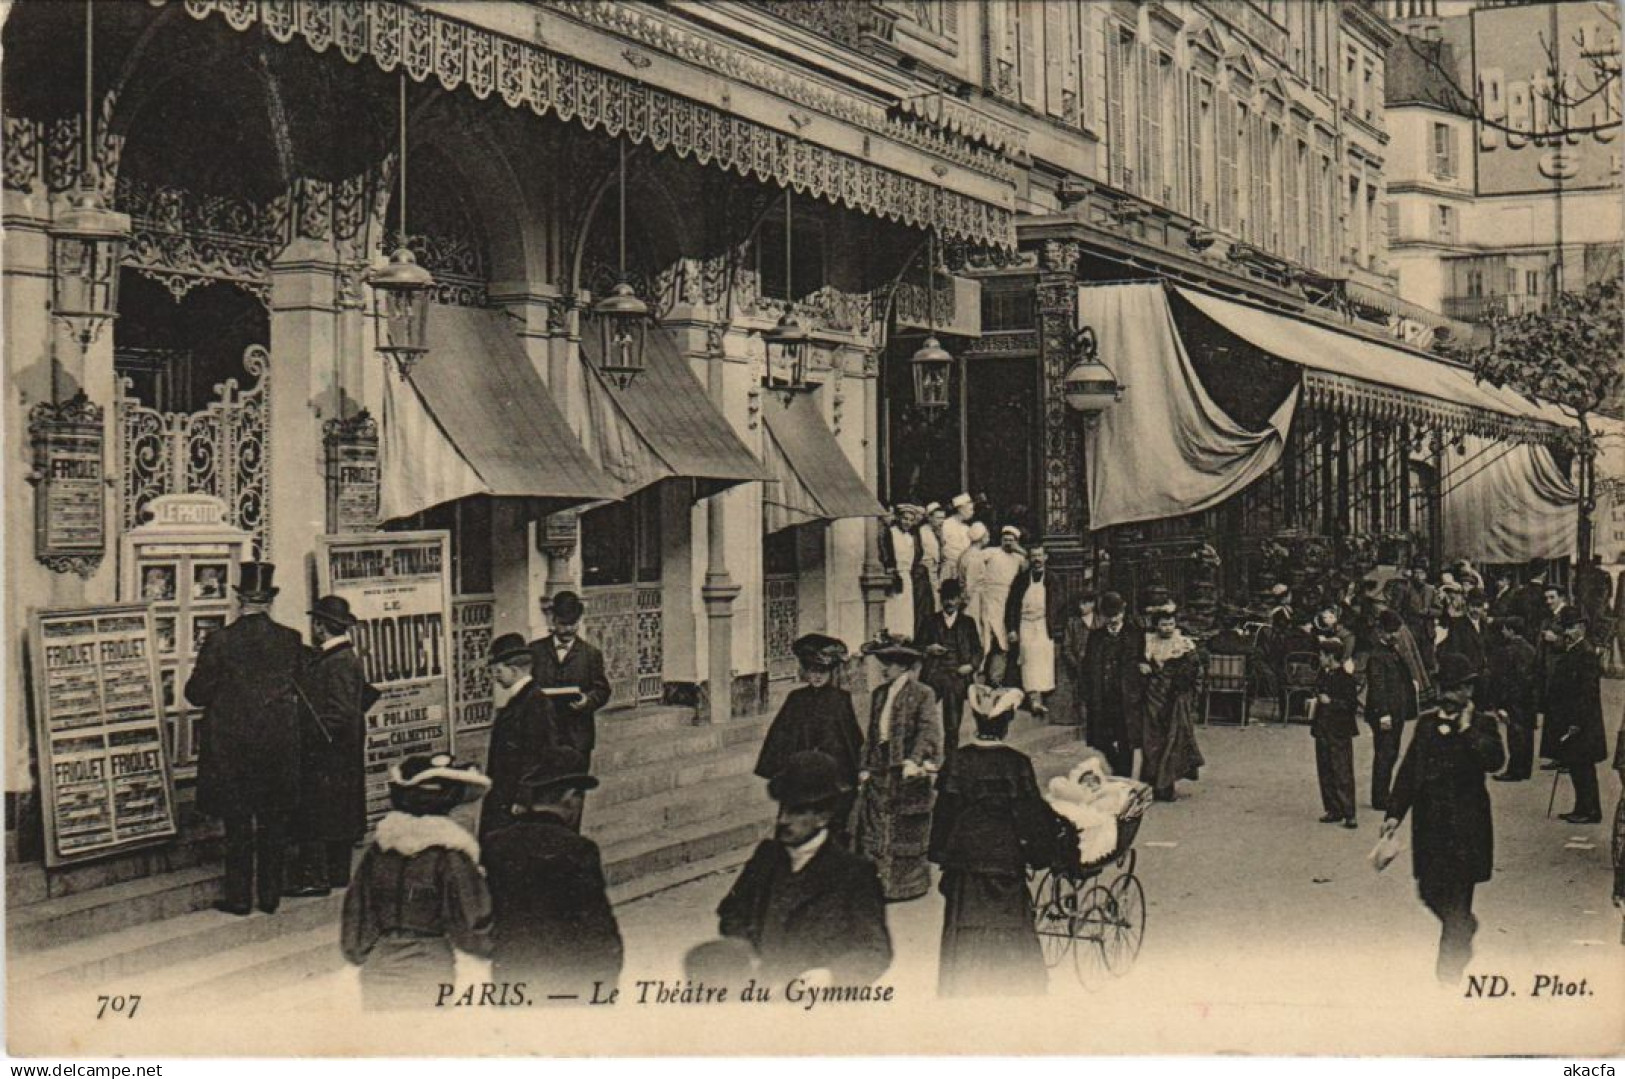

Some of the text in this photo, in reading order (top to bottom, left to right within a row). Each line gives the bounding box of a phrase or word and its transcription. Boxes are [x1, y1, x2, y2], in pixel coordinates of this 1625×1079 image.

[52, 458, 101, 480] FRIQUET
[161, 503, 178, 522] LE
[383, 600, 401, 611] LE
[46, 643, 95, 668] FRIQUET
[100, 637, 146, 661] FRIQUET
[356, 613, 444, 683] RIQUET
[55, 757, 106, 785] FRIQUET
[111, 749, 160, 777] FRIQUET
